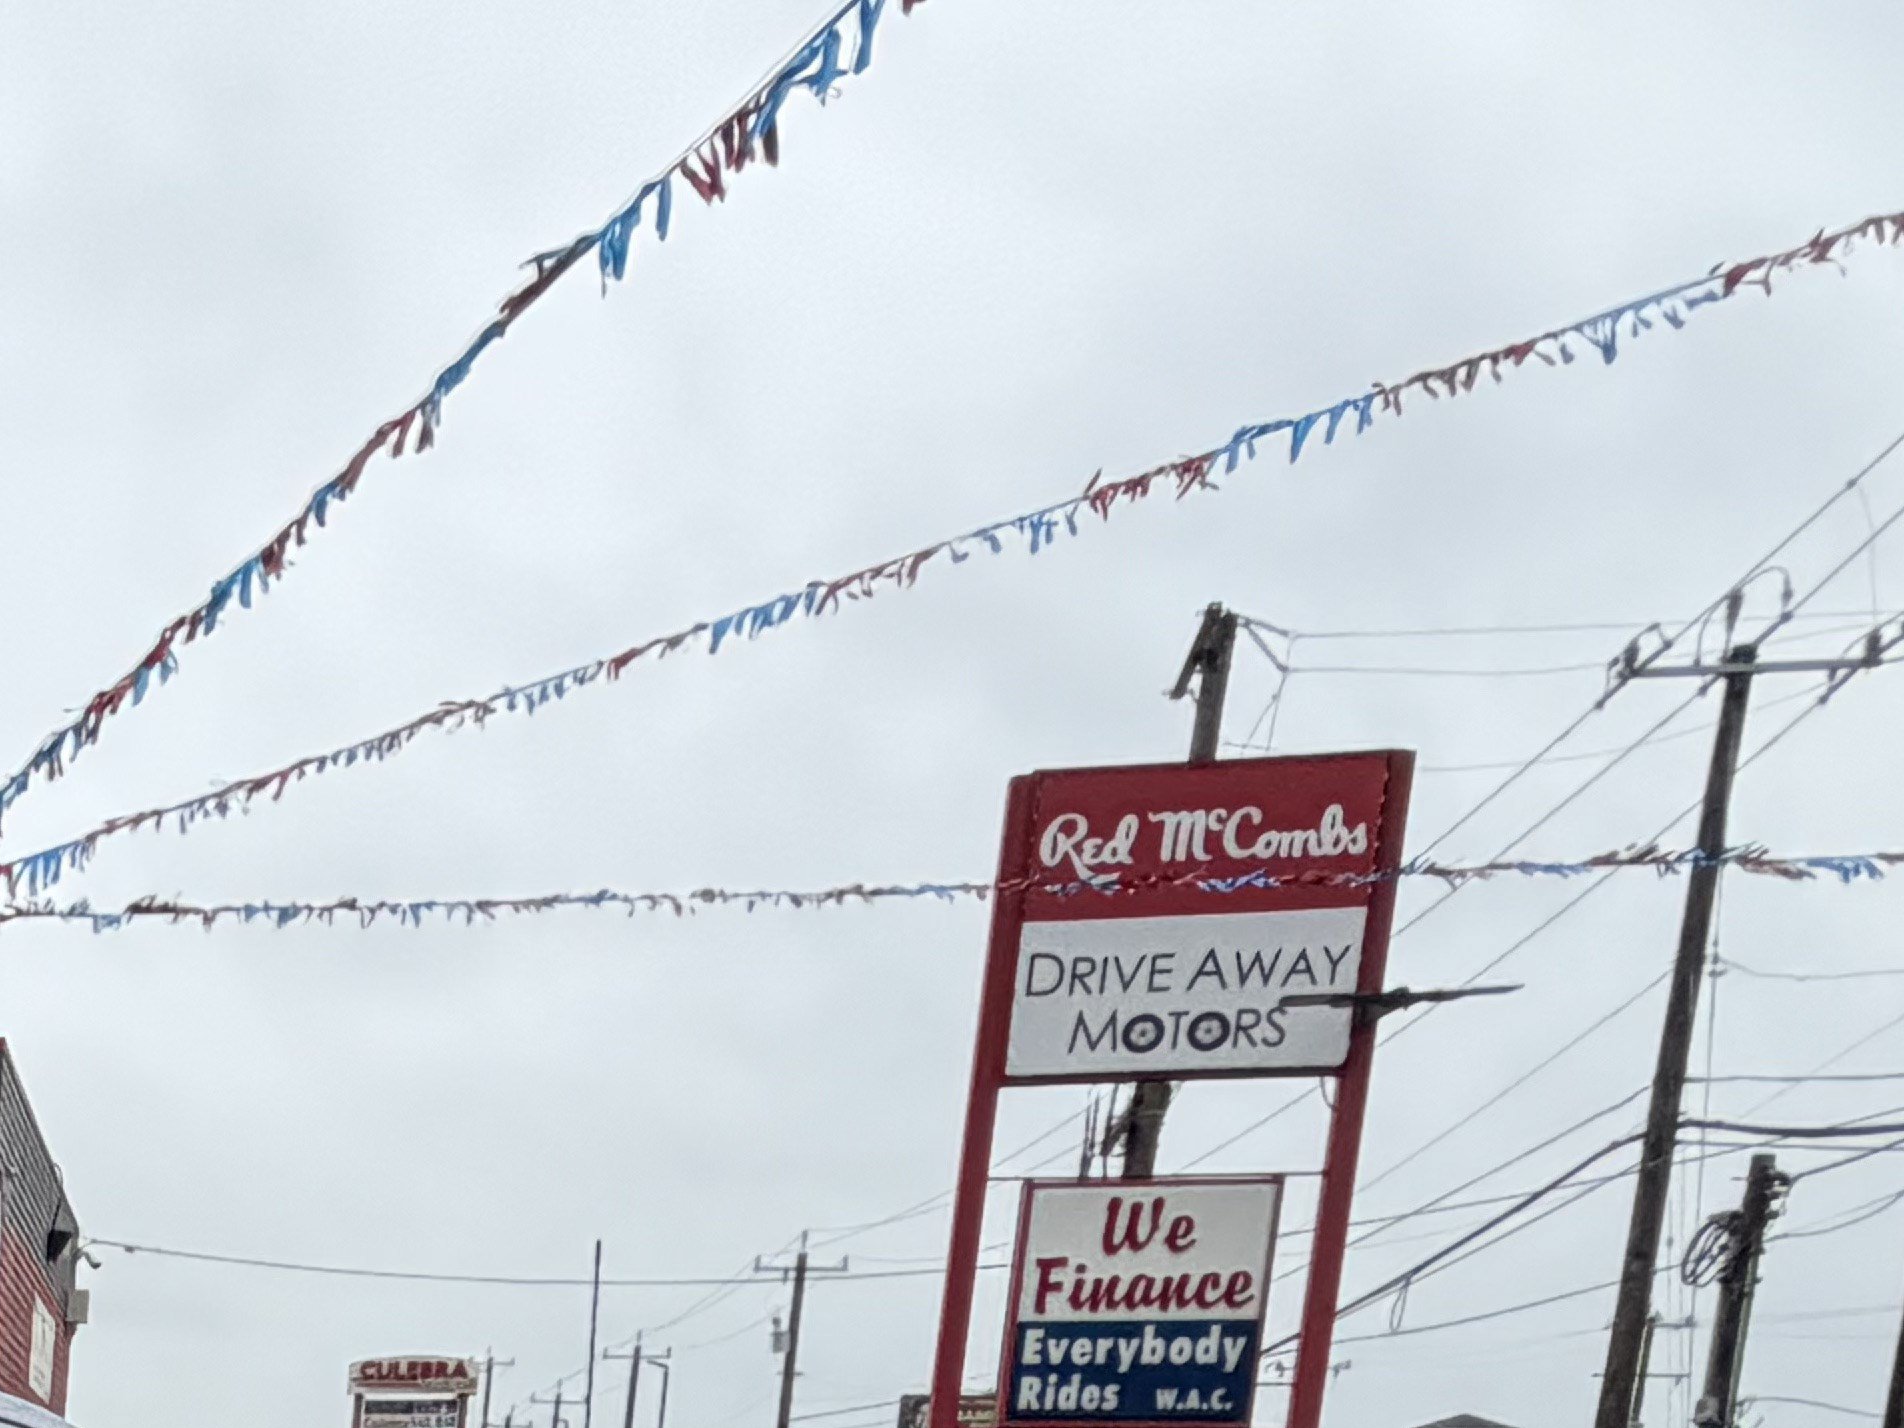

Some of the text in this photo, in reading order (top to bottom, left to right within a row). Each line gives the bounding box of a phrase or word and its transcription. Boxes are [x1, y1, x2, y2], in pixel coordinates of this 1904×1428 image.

[1040, 803, 1368, 884] Red McCombs
[1025, 944, 1352, 997] DRIVE AWAY
[1067, 1006, 1288, 1054] MOTORS
[1102, 1196, 1197, 1256] We
[1034, 1256, 1255, 1314] Finance
[1021, 1324, 1247, 1374] Everybody
[1017, 1373, 1234, 1412] Rides W.A.C.
